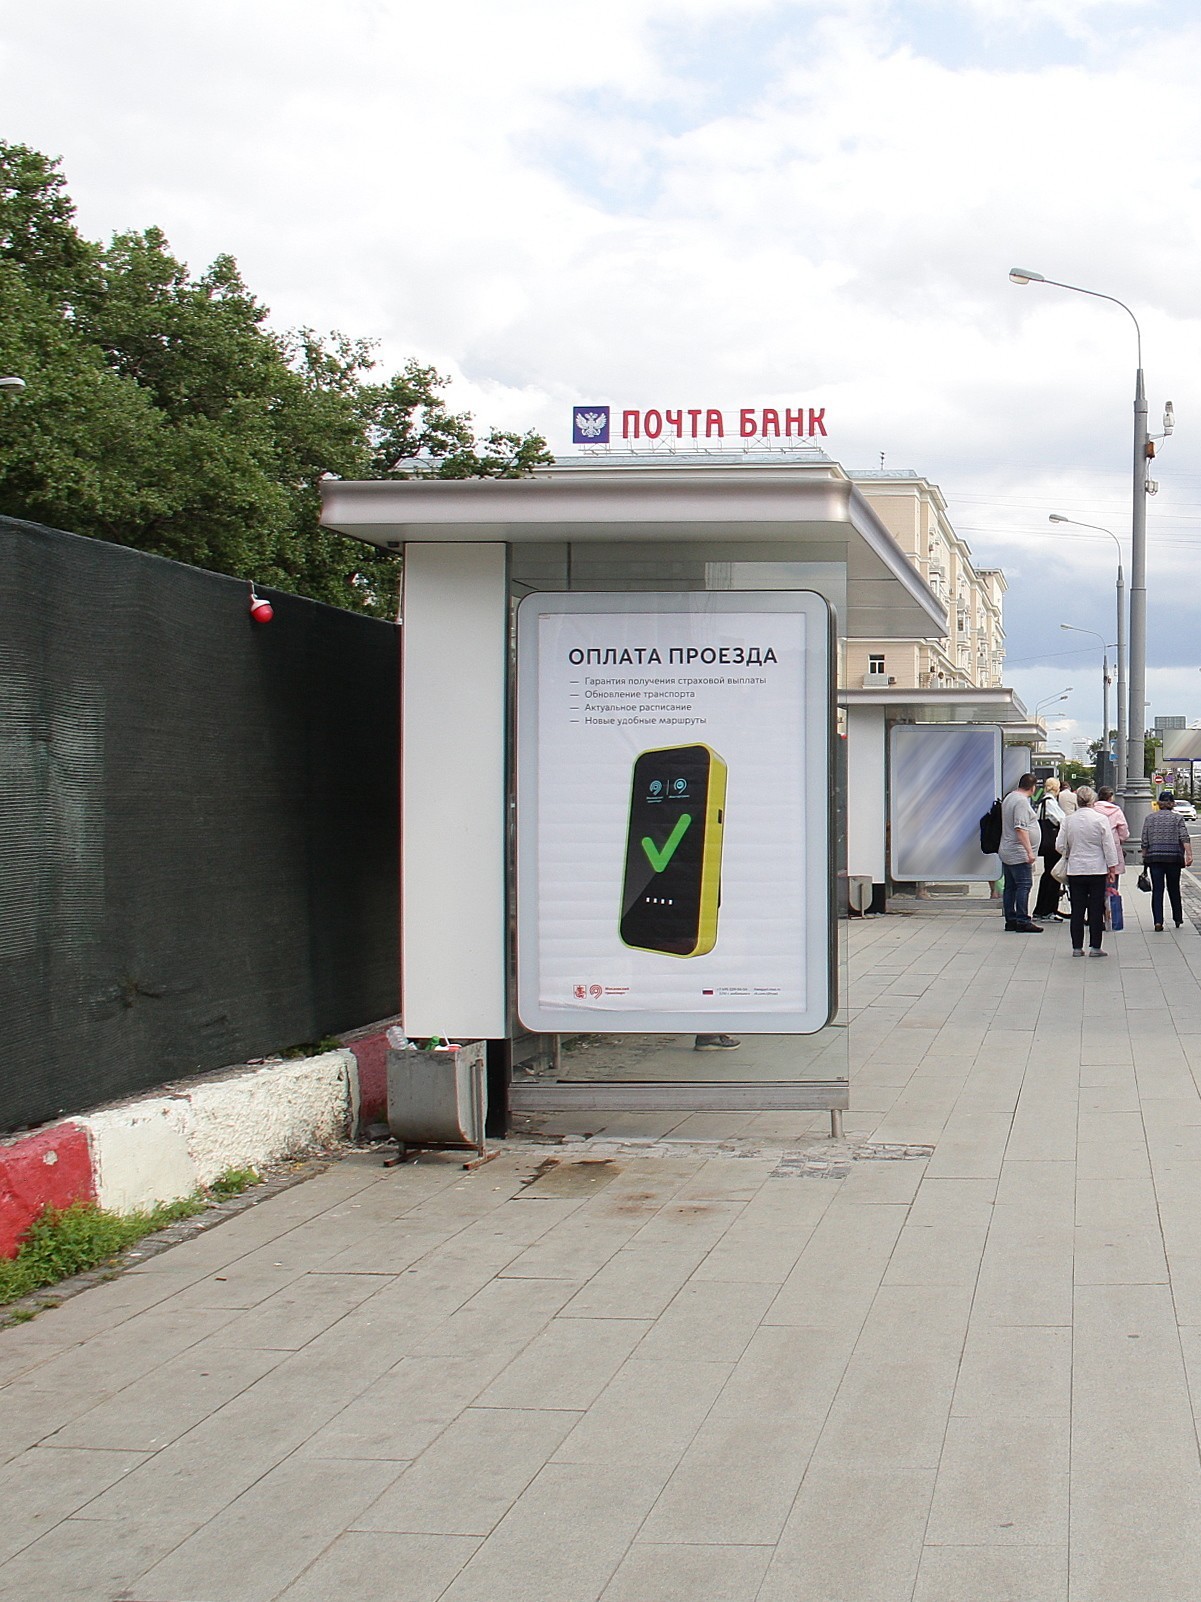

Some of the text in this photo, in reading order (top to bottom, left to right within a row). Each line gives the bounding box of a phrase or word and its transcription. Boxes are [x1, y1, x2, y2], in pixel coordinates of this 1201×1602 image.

[622, 408, 828, 439] ПОЧТА БАНК
[568, 647, 778, 667] ОПЛАТА ПРОЕЗДА
[584, 677, 767, 686] Гарантия получения страховой выплаты
[584, 690, 695, 700] Обновление транспорта
[584, 703, 692, 712] Актуальное расписание
[584, 716, 706, 726] Новые удобные маршруты
